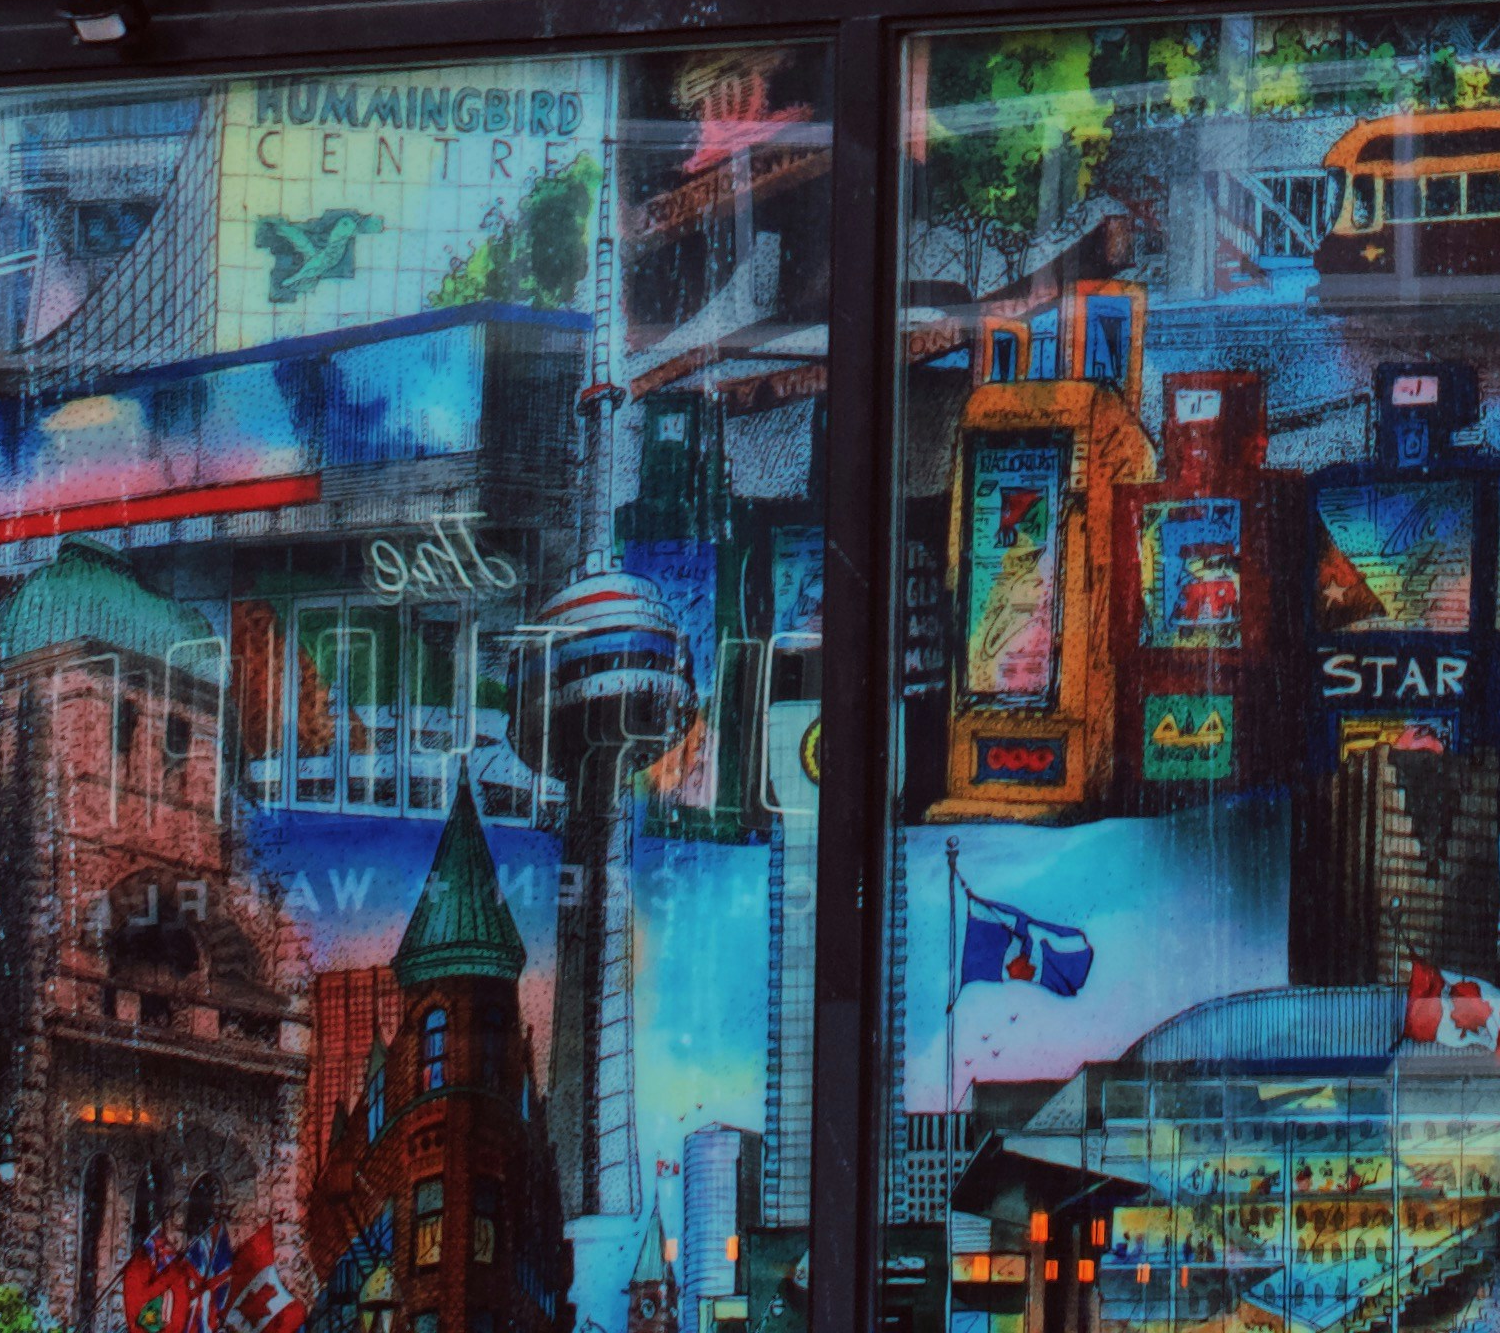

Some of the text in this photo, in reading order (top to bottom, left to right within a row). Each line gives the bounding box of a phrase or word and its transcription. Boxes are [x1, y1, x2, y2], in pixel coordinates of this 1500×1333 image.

[256, 80, 582, 135] HUMMINGBIRD
[256, 129, 572, 180] CENTRE
[1321, 652, 1469, 699] STAR
